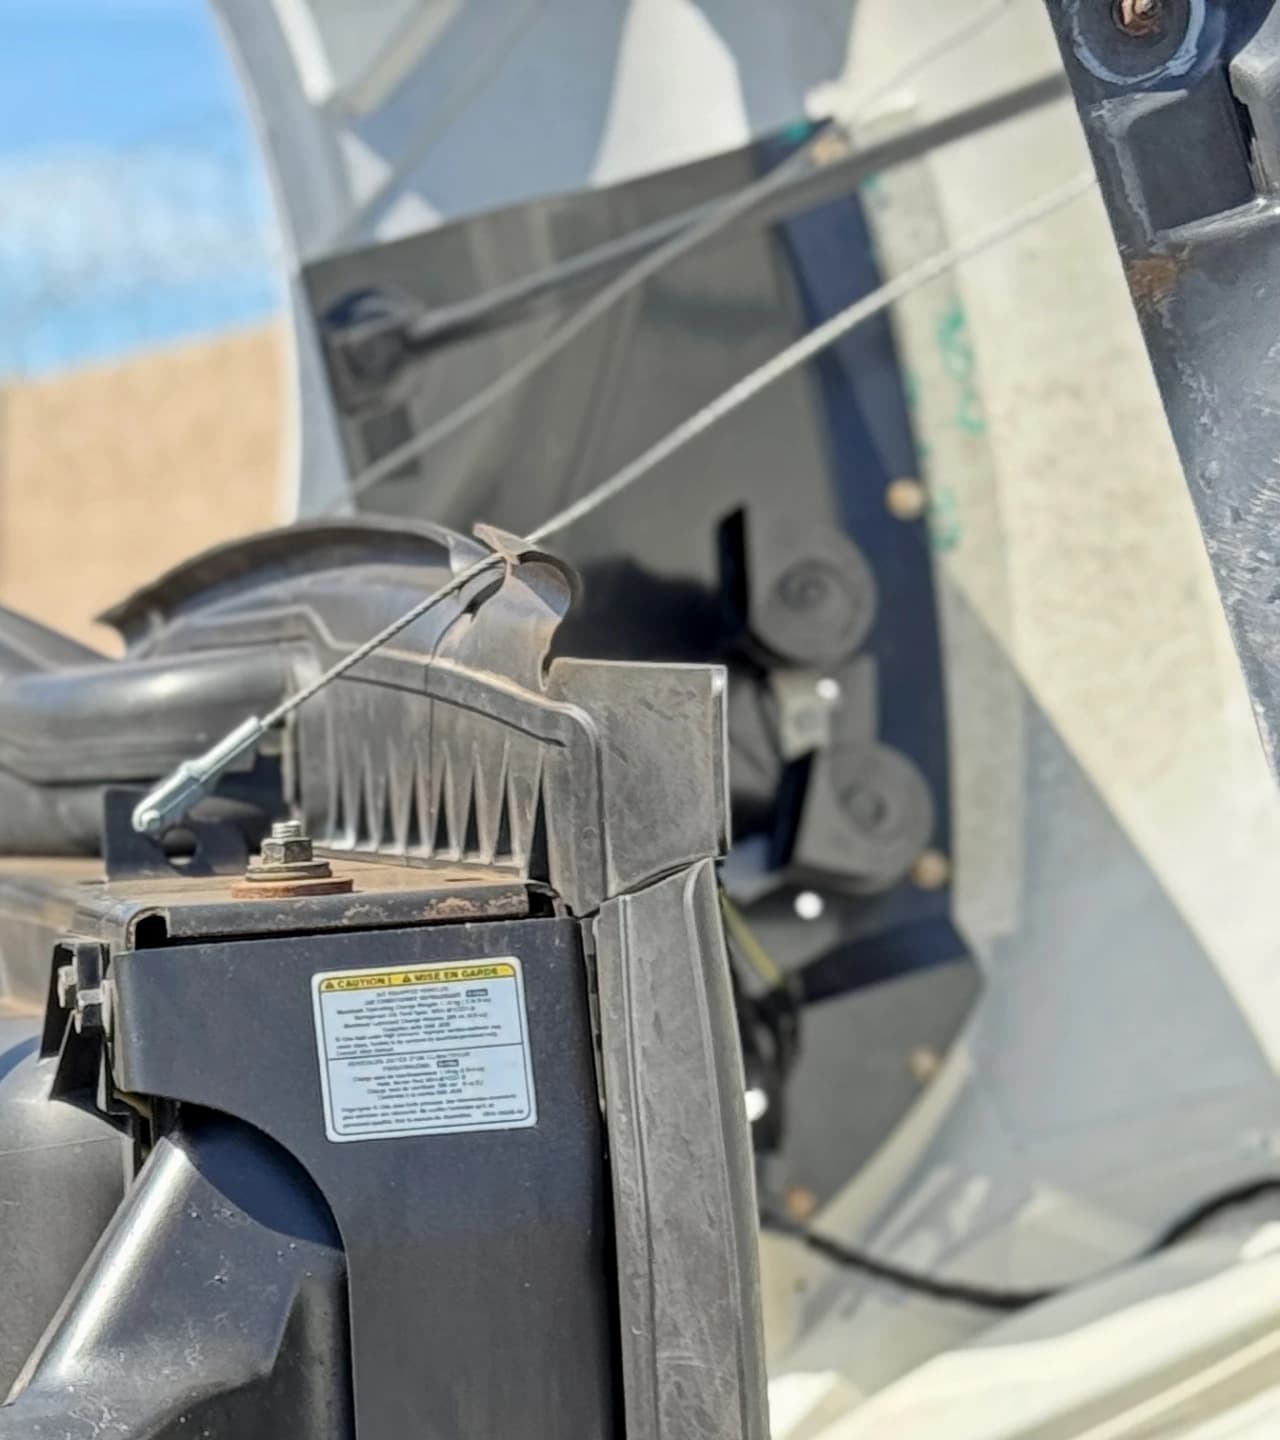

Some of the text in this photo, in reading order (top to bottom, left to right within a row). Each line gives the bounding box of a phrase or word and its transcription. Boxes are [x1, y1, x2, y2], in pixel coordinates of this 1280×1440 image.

[414, 967, 498, 982] MISE EN GARDE
